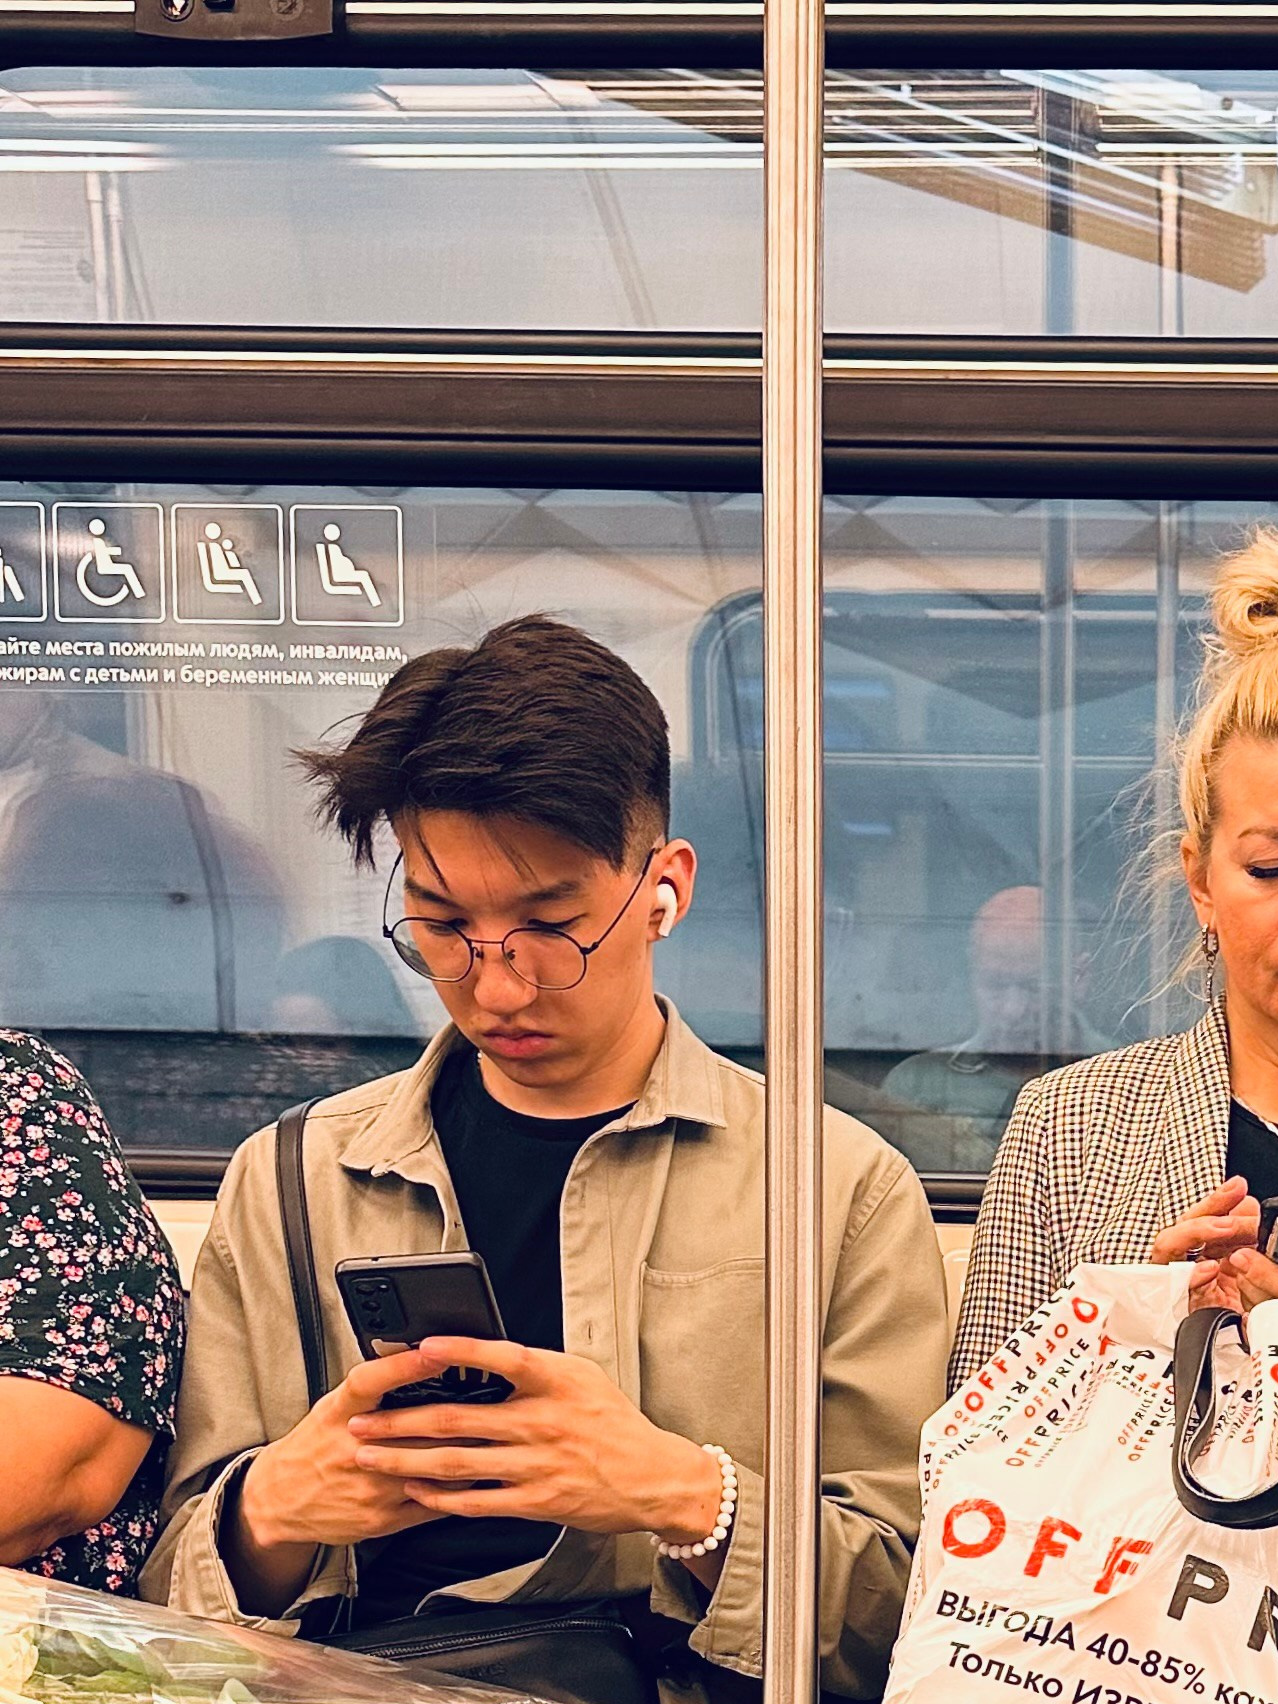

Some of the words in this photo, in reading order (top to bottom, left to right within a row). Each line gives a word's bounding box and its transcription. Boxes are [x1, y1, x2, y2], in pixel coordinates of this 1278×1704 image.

[0, 637, 41, 655] айте
[45, 641, 104, 656] места
[109, 641, 205, 657] пожилым
[209, 643, 284, 661] людям,
[289, 644, 407, 664] инвалидам,
[0, 667, 66, 684] жирам
[69, 668, 81, 682] с
[84, 667, 158, 684] детьми
[163, 669, 176, 683] и
[180, 665, 313, 687] беременным
[317, 671, 395, 689] женщи
[936, 1590, 1076, 1651] ВЫГОДА
[1086, 1632, 1206, 1695] 40-85%
[948, 1641, 1063, 1698] Только
